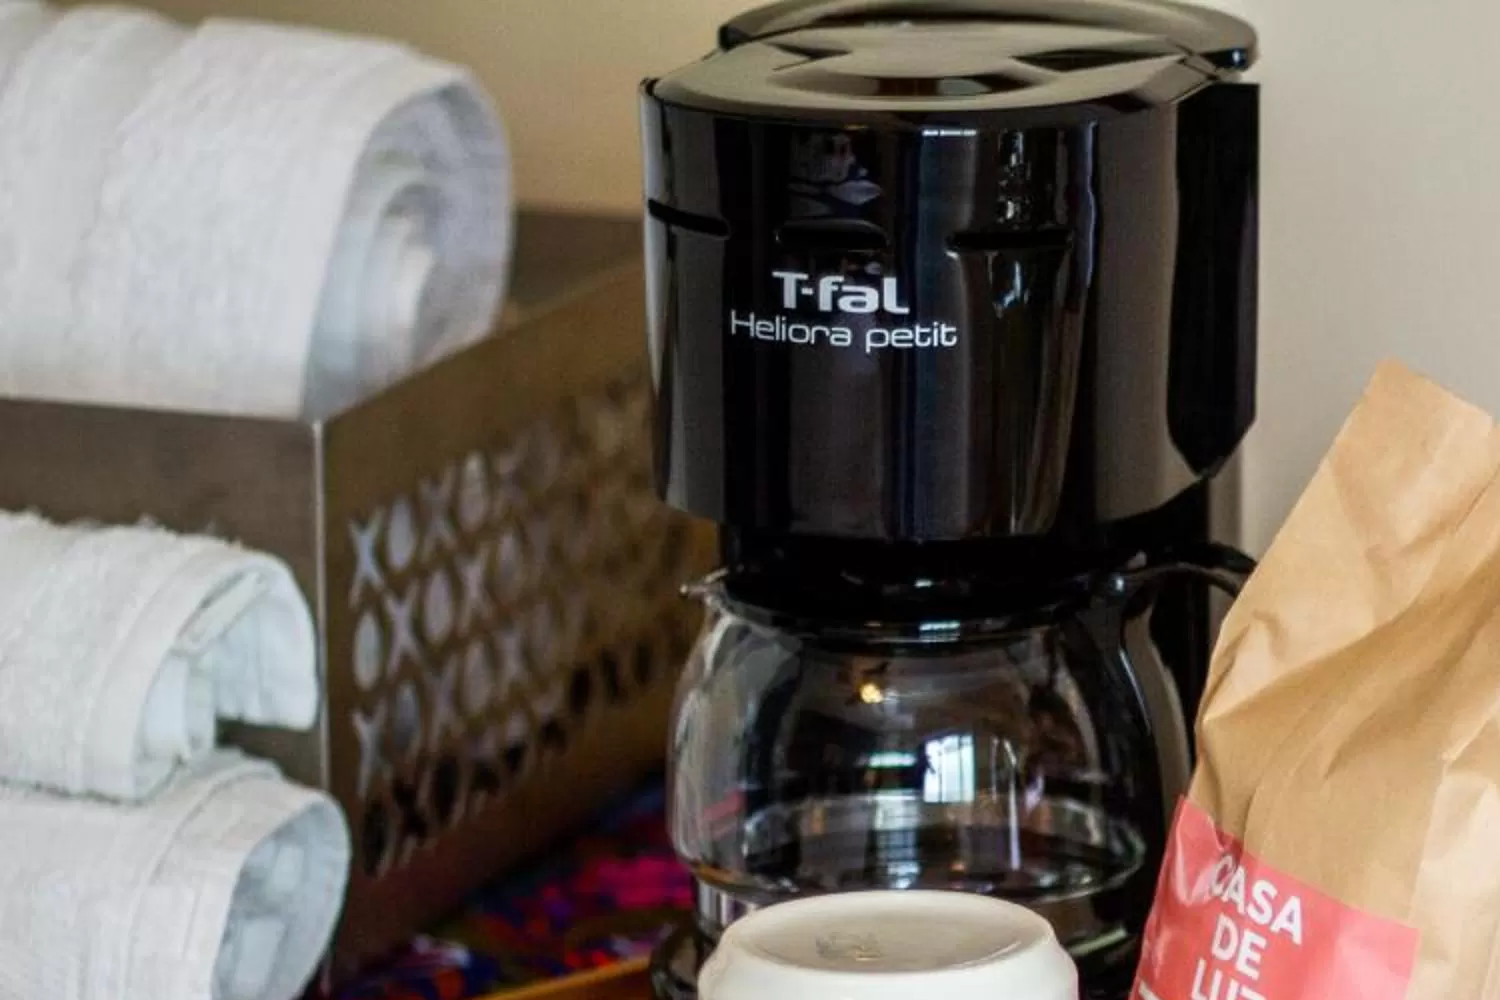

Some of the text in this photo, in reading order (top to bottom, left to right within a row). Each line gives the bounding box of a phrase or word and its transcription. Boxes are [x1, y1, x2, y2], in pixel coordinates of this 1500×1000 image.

[772, 271, 909, 314] T-fal
[731, 309, 957, 353] Heliora petit
[1210, 853, 1303, 945] CASA
[1211, 912, 1268, 981] DE
